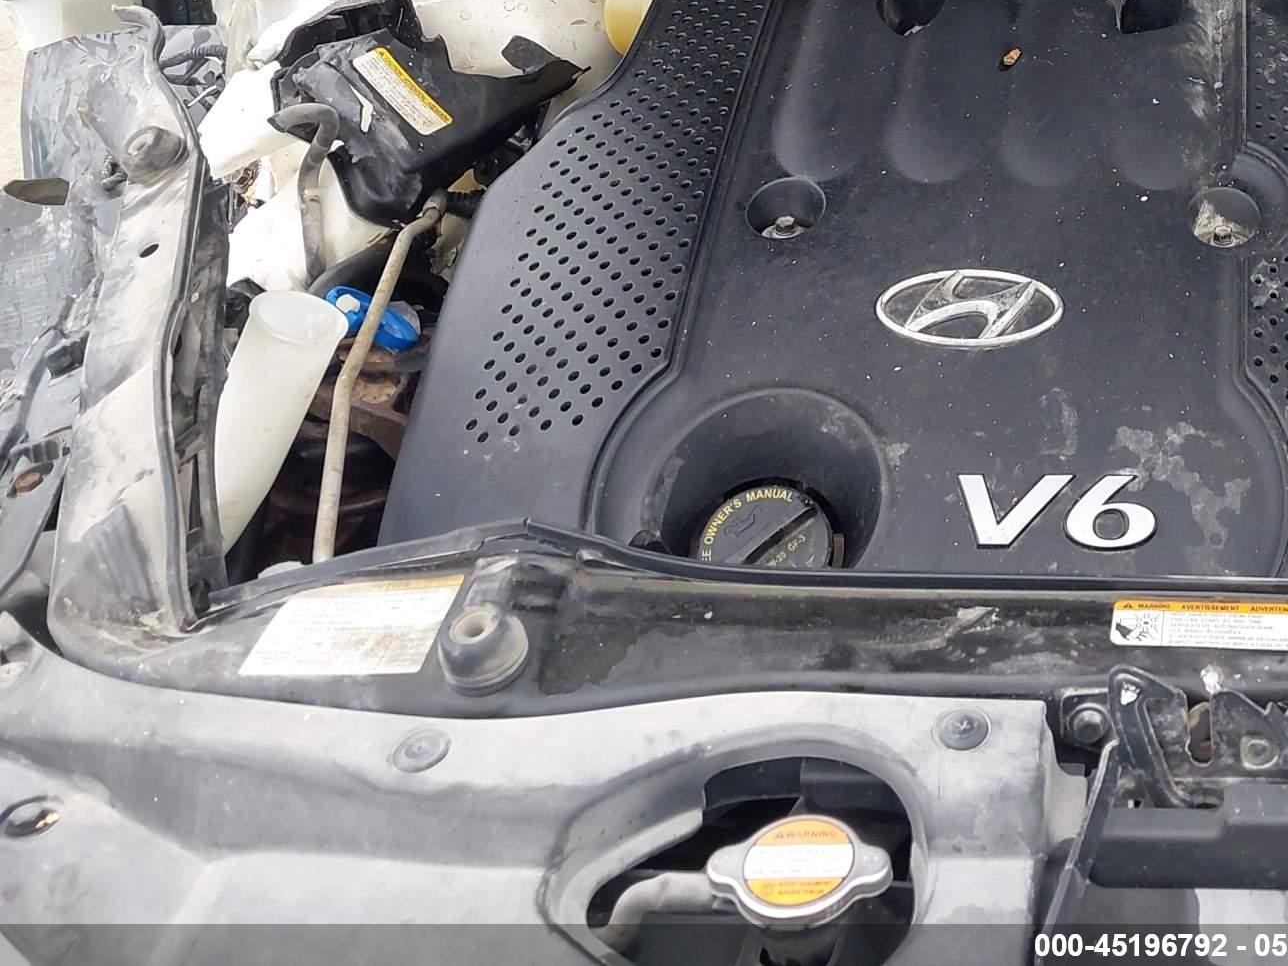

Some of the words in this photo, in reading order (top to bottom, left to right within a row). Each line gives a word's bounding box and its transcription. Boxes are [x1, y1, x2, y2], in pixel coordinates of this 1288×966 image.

[704, 498, 742, 545] OWNER'S
[745, 487, 793, 503] MANUAL
[957, 473, 1158, 551] V6
[1181, 604, 1240, 612] AVERTISSEMENT
